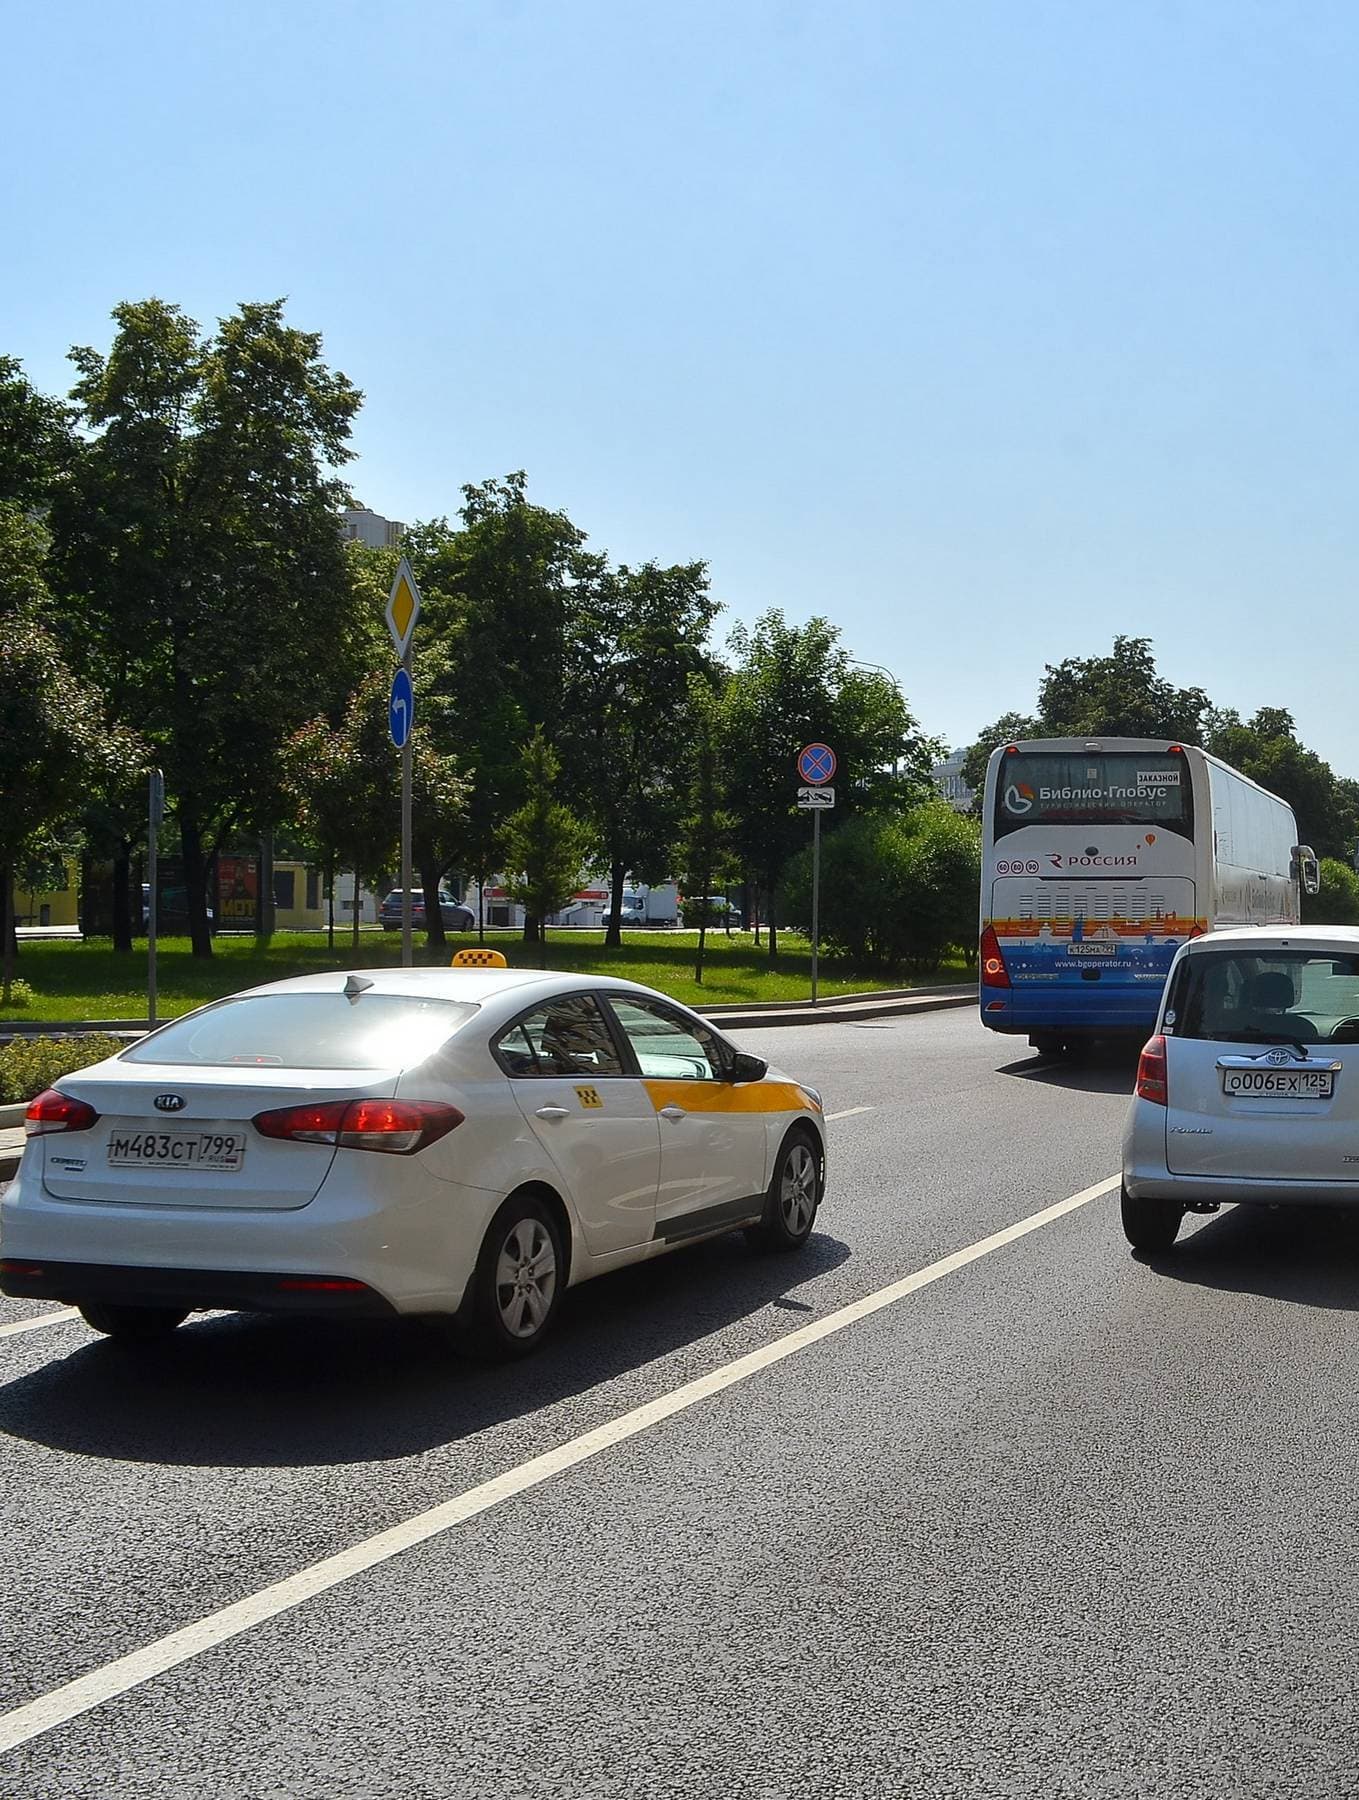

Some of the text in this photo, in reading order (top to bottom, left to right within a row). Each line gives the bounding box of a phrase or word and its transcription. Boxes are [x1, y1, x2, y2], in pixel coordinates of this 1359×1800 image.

[1139, 773, 1179, 783] ЗАКАЗНОЙ
[1068, 856, 1137, 866] РОССИЯ
[1055, 959, 1132, 969] www.bgoperator.ru
[157, 1097, 180, 1108] KIA
